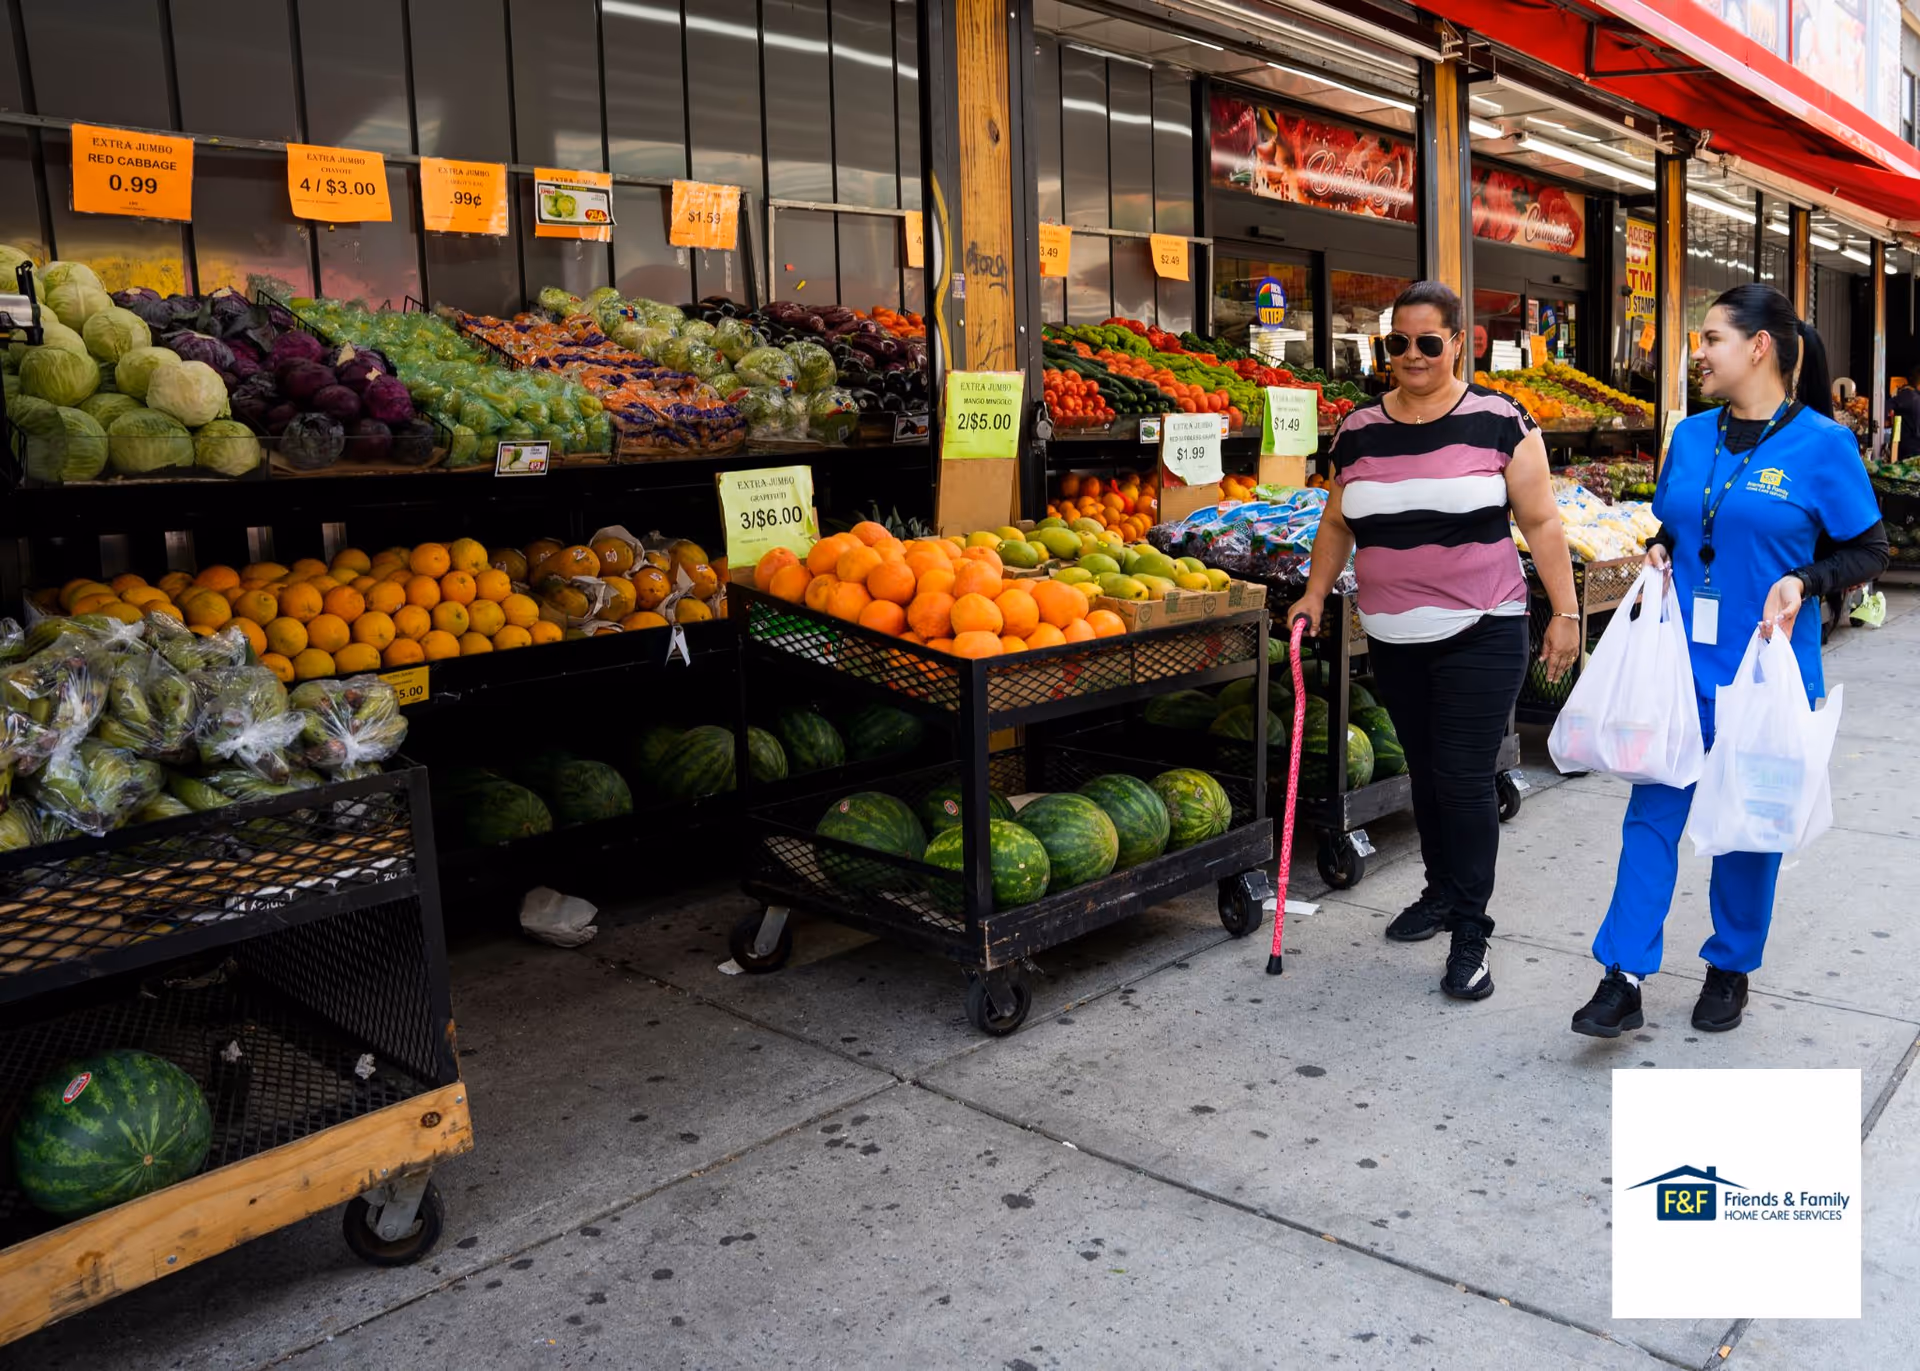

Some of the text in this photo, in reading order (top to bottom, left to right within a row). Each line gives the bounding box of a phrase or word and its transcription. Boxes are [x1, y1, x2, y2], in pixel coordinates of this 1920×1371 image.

[92, 137, 173, 154] EXTRA JUMBO
[88, 153, 177, 171] RED CABBAGE
[306, 153, 366, 165] EXTRA JUMBO
[438, 166, 490, 177] EXTRA JUMBO
[109, 174, 158, 194] 0.99
[300, 177, 311, 192] 4
[326, 178, 376, 197] $3.00
[450, 191, 482, 209] .99¢
[688, 211, 721, 225] $1.59
[1040, 246, 1058, 258] 3.49
[1626, 243, 1651, 267] BT
[1160, 254, 1180, 266] $2.49
[1626, 268, 1652, 292] TM
[960, 382, 1012, 392] EXTRA JUMBO
[963, 397, 985, 405] MANGO
[957, 412, 1011, 434] 2/$5.00
[1273, 416, 1300, 431] $1.49
[1176, 446, 1205, 462] $1.99
[737, 476, 795, 490] EXTRA JUMBO
[740, 505, 802, 531] 3/$6.00
[396, 685, 423, 699] 5.00
